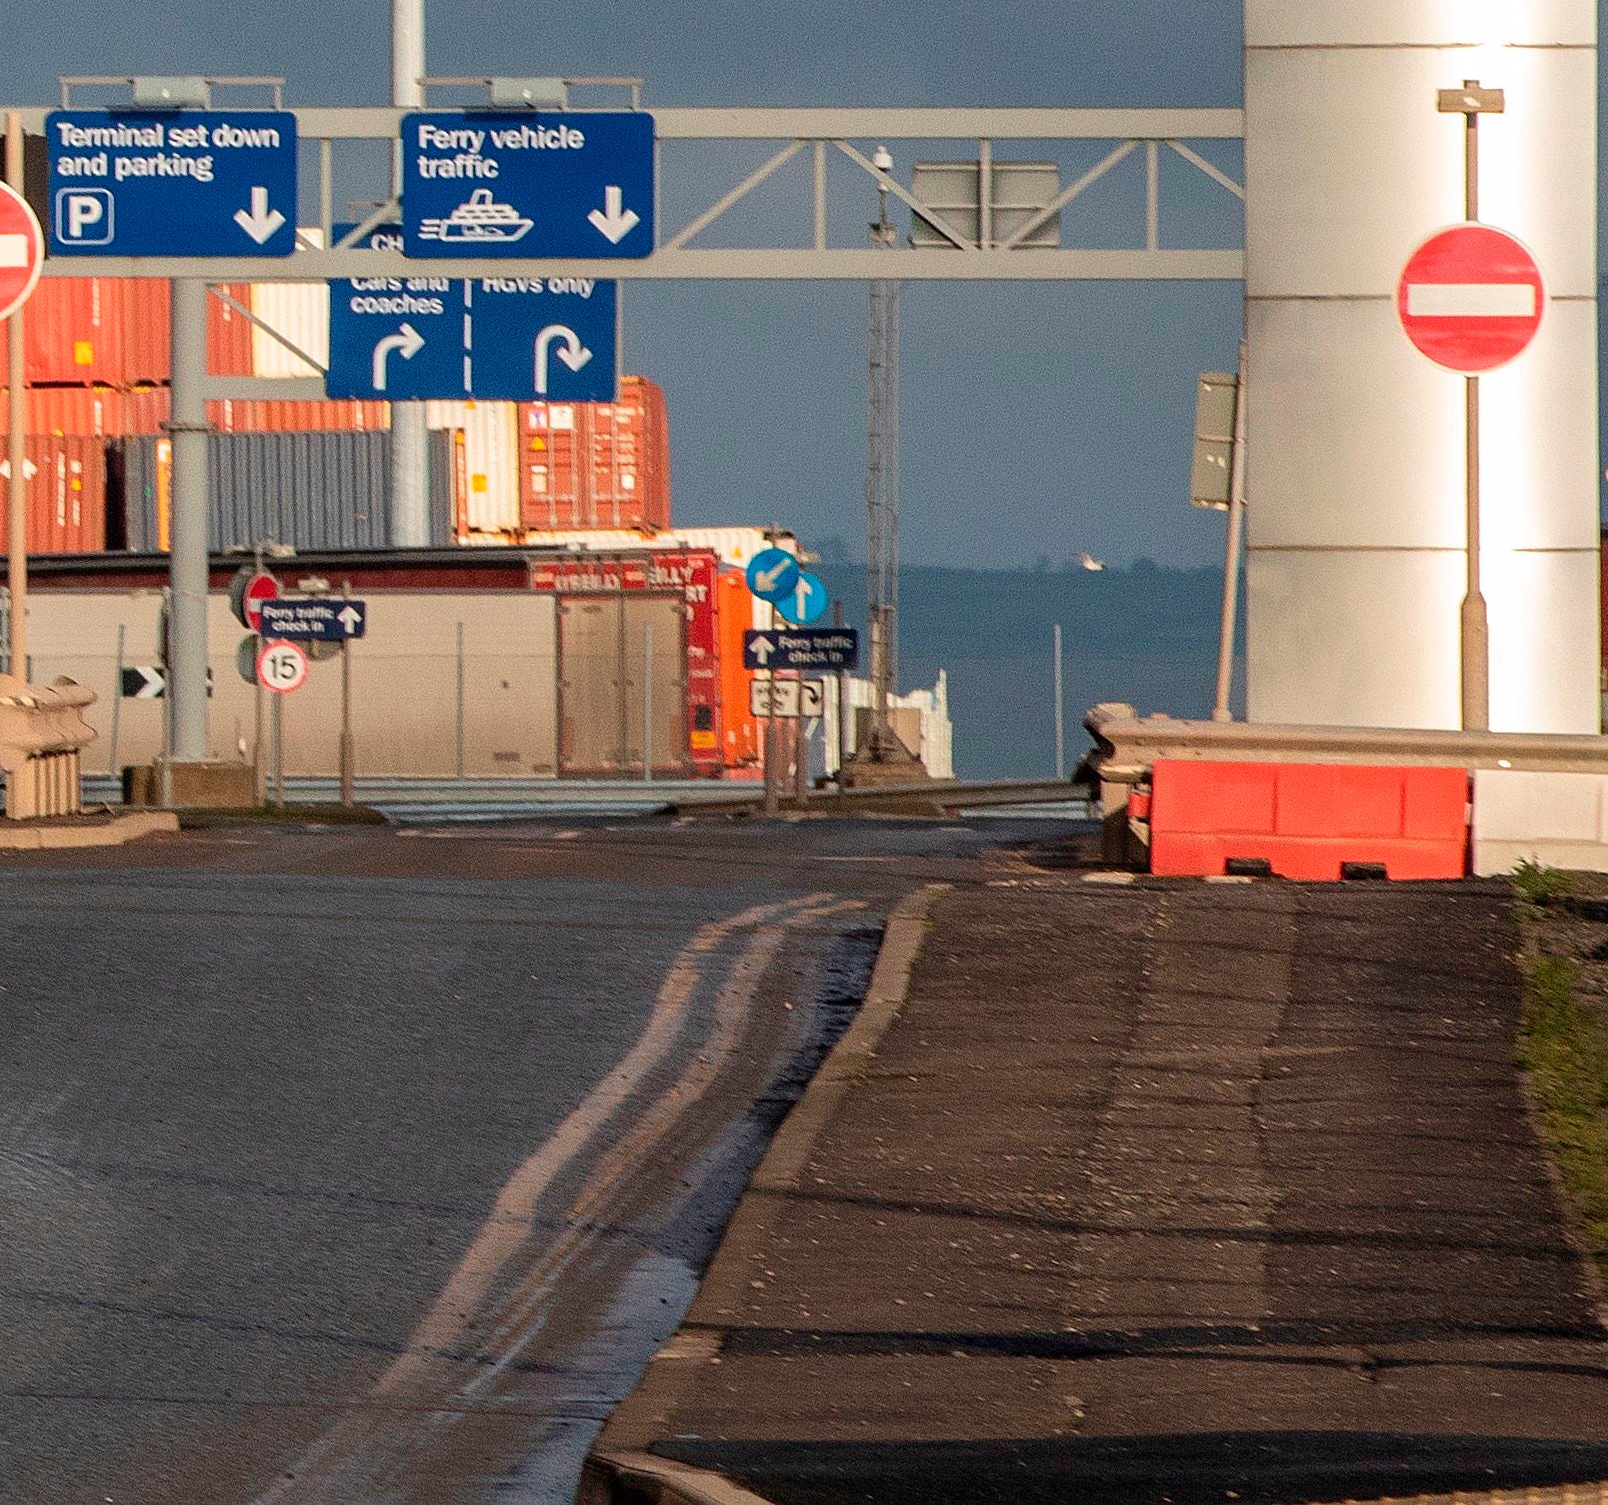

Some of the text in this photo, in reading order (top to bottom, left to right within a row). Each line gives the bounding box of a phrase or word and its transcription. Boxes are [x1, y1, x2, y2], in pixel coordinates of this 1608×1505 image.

[56, 122, 280, 148] Terminal set down
[417, 124, 585, 153] Ferry vehicle
[57, 153, 215, 183] and parking
[417, 154, 500, 178] traffic
[68, 195, 104, 238] P
[350, 294, 444, 314] coaches
[295, 606, 335, 620] traffic
[269, 654, 297, 680] 15
